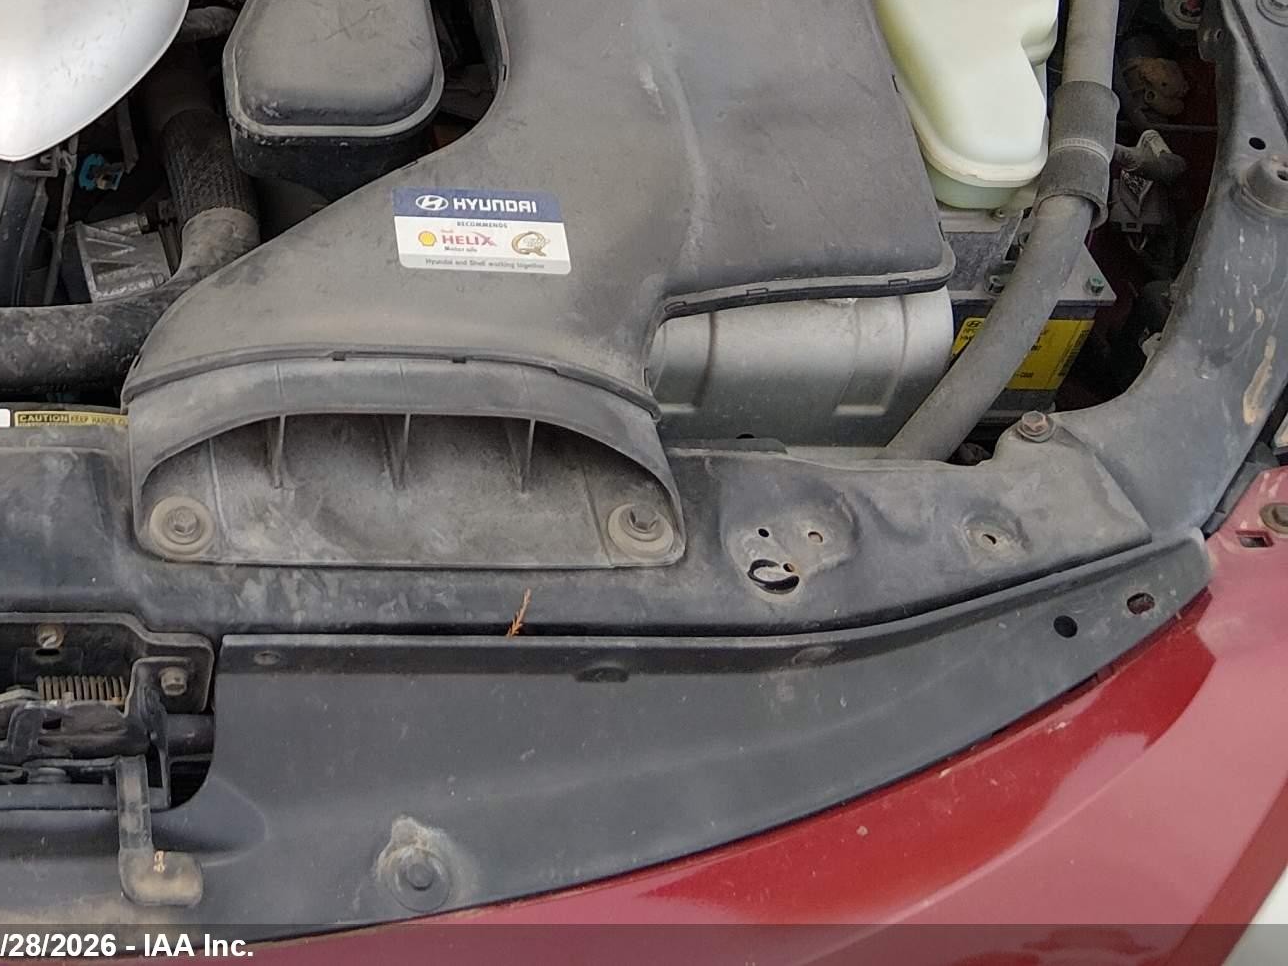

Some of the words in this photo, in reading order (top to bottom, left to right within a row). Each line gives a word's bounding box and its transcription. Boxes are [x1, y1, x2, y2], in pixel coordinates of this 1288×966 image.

[453, 197, 537, 213] HYUNDAI
[457, 221, 508, 229] RECOMMENDS
[442, 232, 496, 246] HELIX
[19, 414, 69, 423] CAUTION
